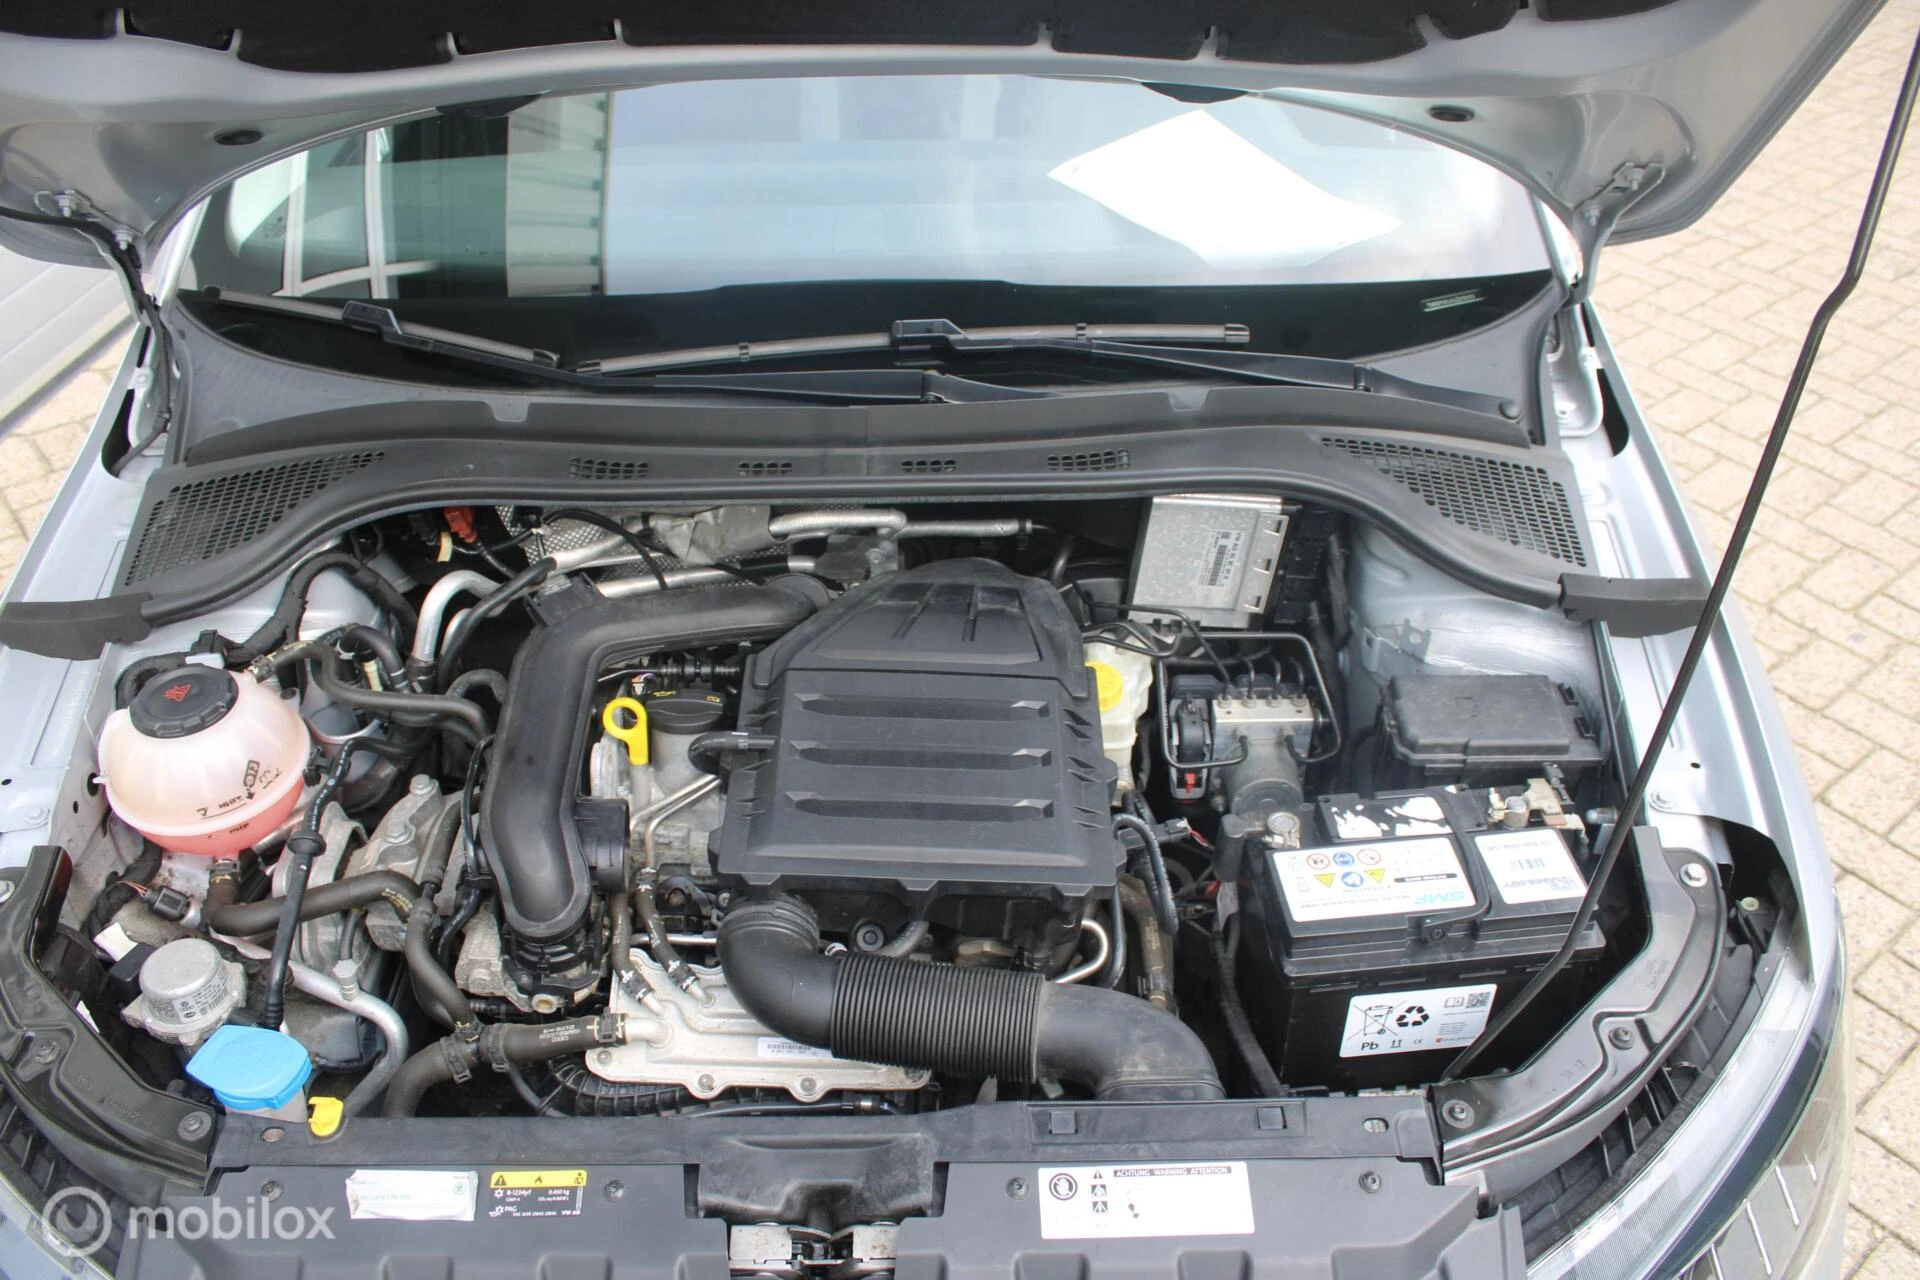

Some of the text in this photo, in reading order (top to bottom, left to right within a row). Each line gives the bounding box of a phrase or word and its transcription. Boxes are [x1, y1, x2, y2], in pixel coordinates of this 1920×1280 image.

[1413, 890, 1466, 906] SMF
[1361, 1042, 1379, 1051] Pb
[1116, 1168, 1150, 1176] ACHTUNG
[1154, 1168, 1187, 1176] WARNING
